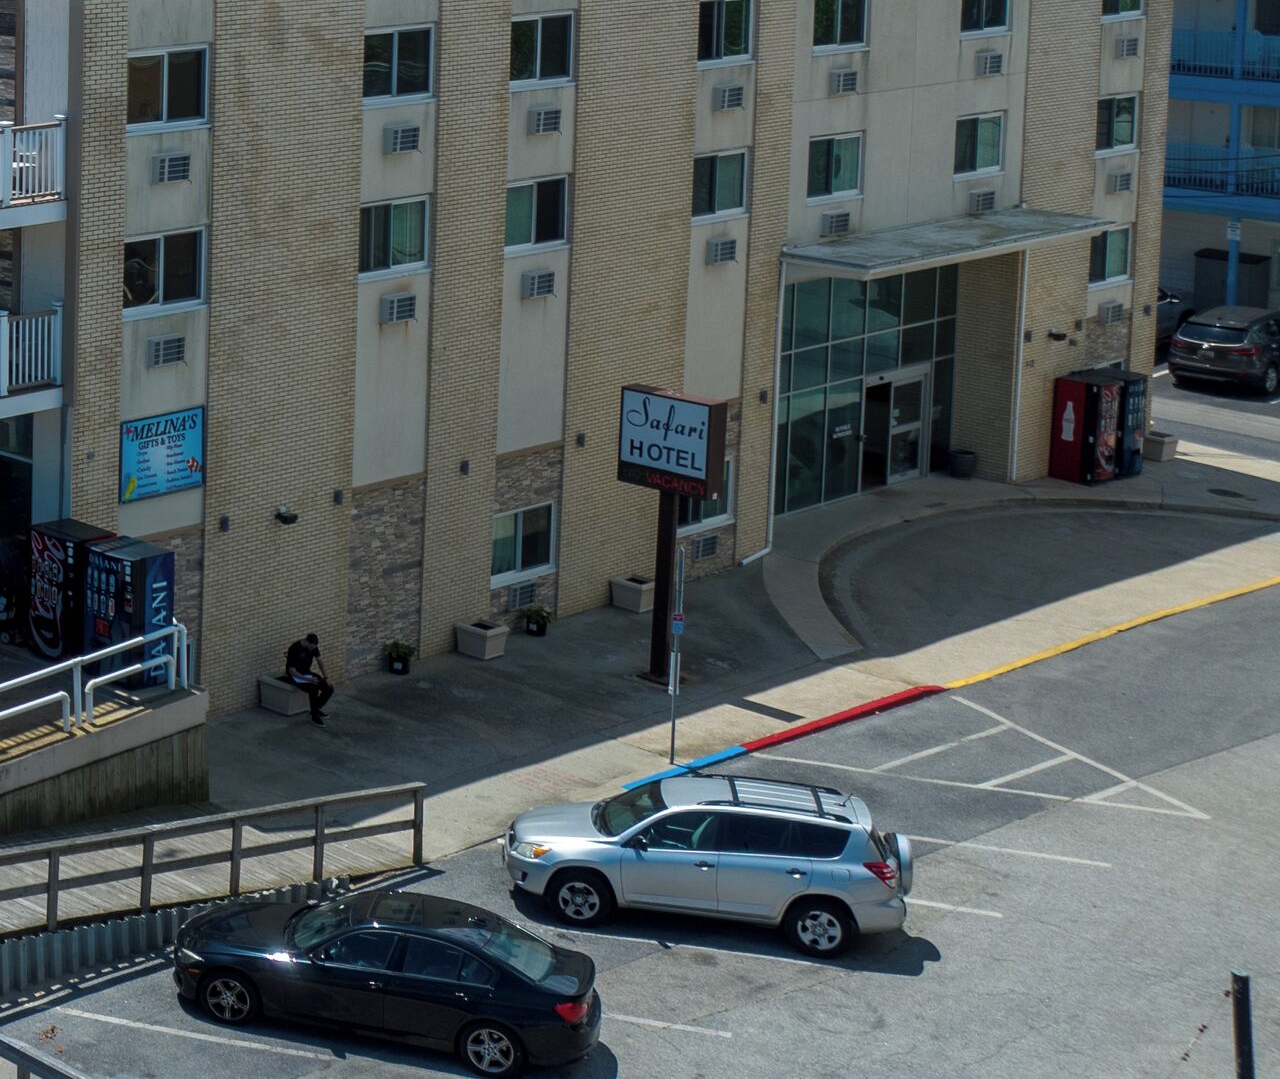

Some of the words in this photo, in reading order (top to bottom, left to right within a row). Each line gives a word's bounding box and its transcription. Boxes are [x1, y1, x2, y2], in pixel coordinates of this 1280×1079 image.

[131, 413, 198, 442] MELINA'S
[626, 396, 705, 441] Safari
[138, 438, 159, 451] GIFTS
[160, 437, 166, 446] &
[167, 432, 186, 445] TOYS
[629, 438, 703, 472] HOTEL
[646, 473, 705, 496] VACANCY
[150, 580, 168, 678] DAANI
